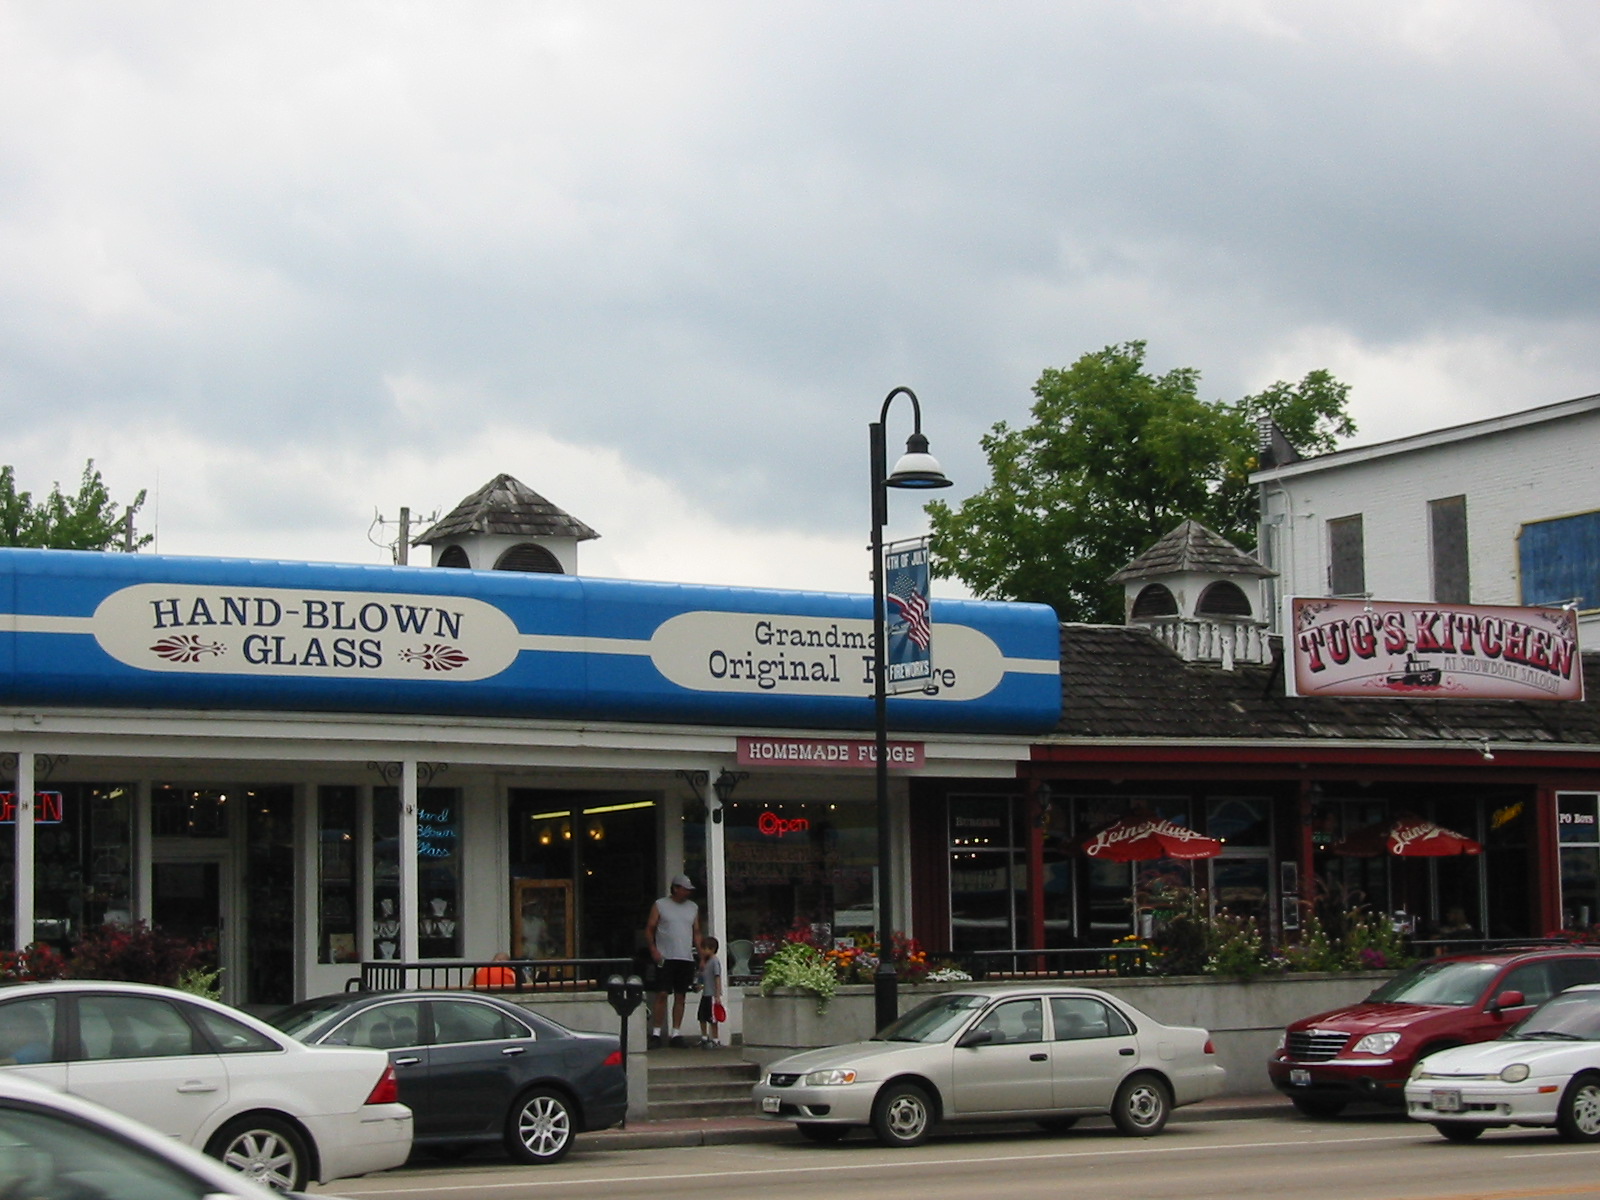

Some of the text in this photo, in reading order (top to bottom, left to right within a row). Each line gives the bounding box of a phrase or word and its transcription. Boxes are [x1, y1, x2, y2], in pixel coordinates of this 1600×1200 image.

[900, 553, 910, 568] OF
[149, 597, 464, 639] HAND-BLOWN
[242, 634, 383, 668] GLASS
[1297, 610, 1577, 681] TUG'S KITCHEN
[708, 651, 840, 690] Original
[889, 660, 930, 680] FIREWORKS
[1522, 666, 1561, 692] SALOON
[749, 742, 915, 763] HOMEMADE FUGE
[758, 811, 811, 837] Open
